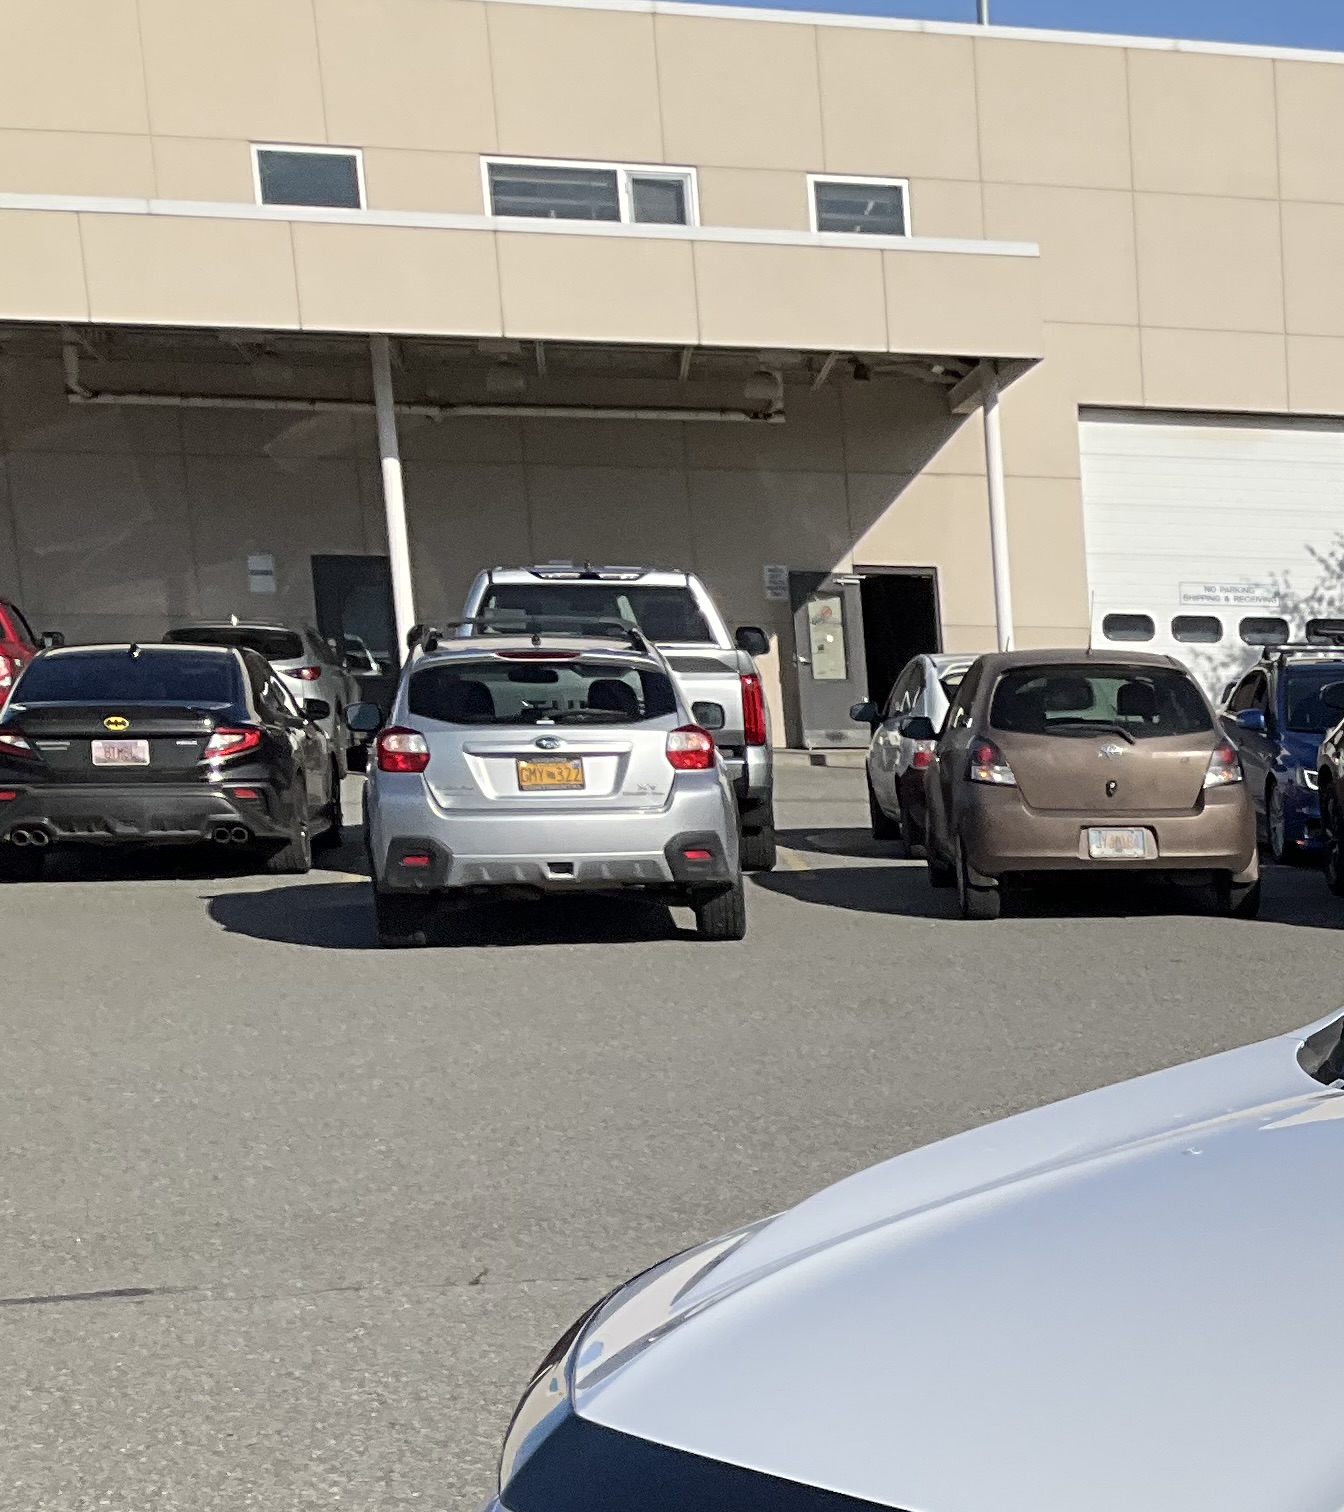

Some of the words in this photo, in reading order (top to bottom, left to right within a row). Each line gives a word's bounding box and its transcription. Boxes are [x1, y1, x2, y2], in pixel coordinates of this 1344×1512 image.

[1204, 585, 1217, 593] NO
[1219, 585, 1255, 594] PARKING
[1183, 594, 1220, 603] SHIPPING
[555, 766, 580, 783] 322
